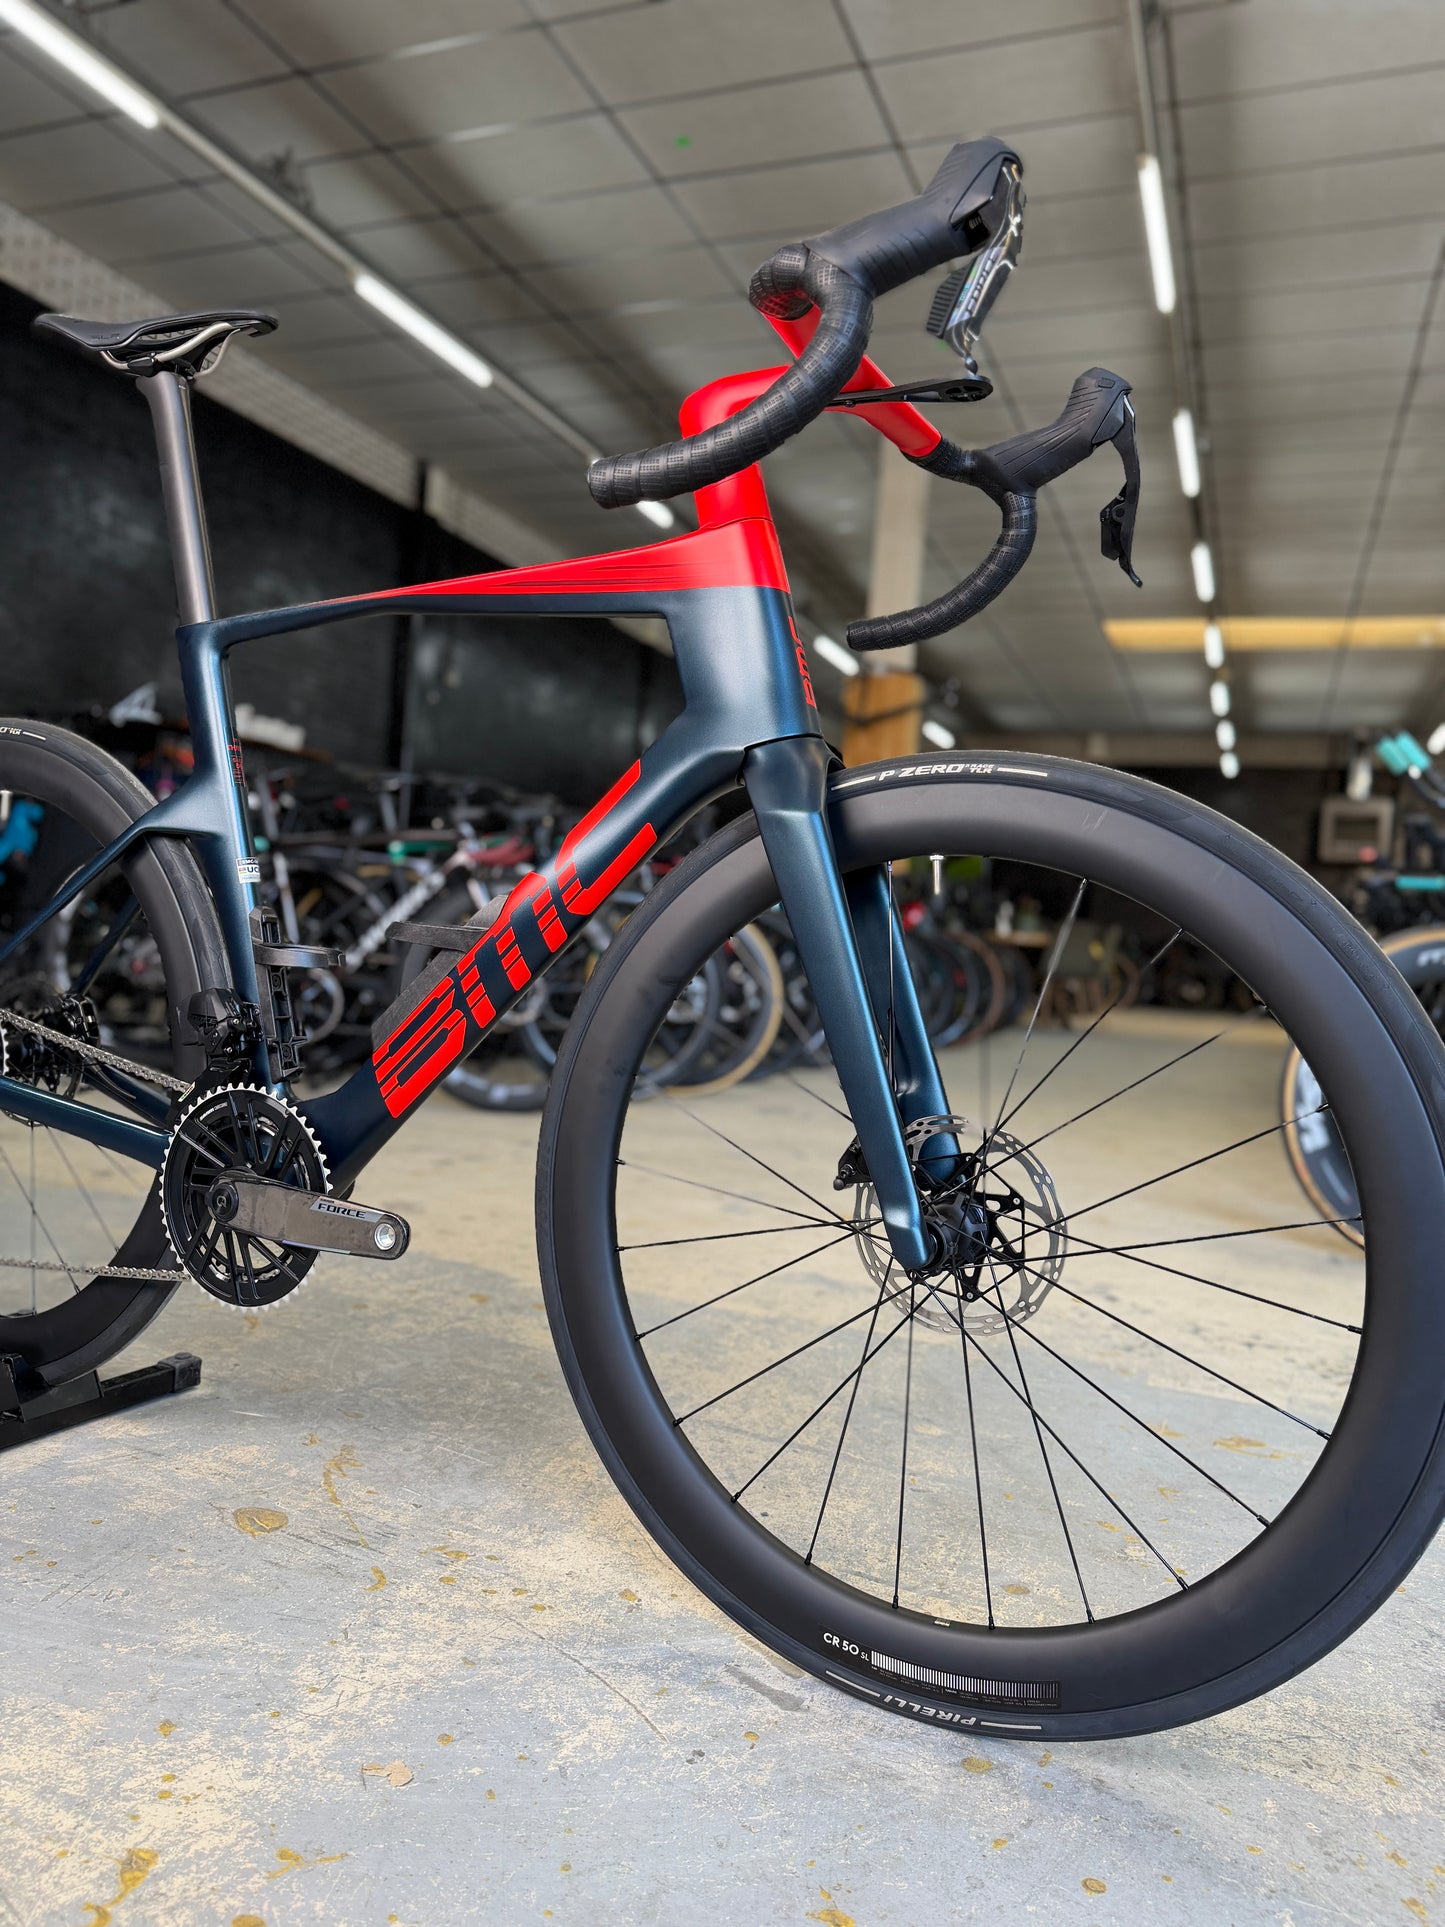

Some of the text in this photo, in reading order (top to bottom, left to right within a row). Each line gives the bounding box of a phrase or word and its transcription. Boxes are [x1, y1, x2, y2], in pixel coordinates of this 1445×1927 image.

[878, 769, 896, 782] P
[898, 763, 965, 778] ZERO
[317, 1202, 367, 1219] FORCE
[823, 1632, 870, 1662] CR 50 SL
[883, 1694, 977, 1726] PIRELLI
